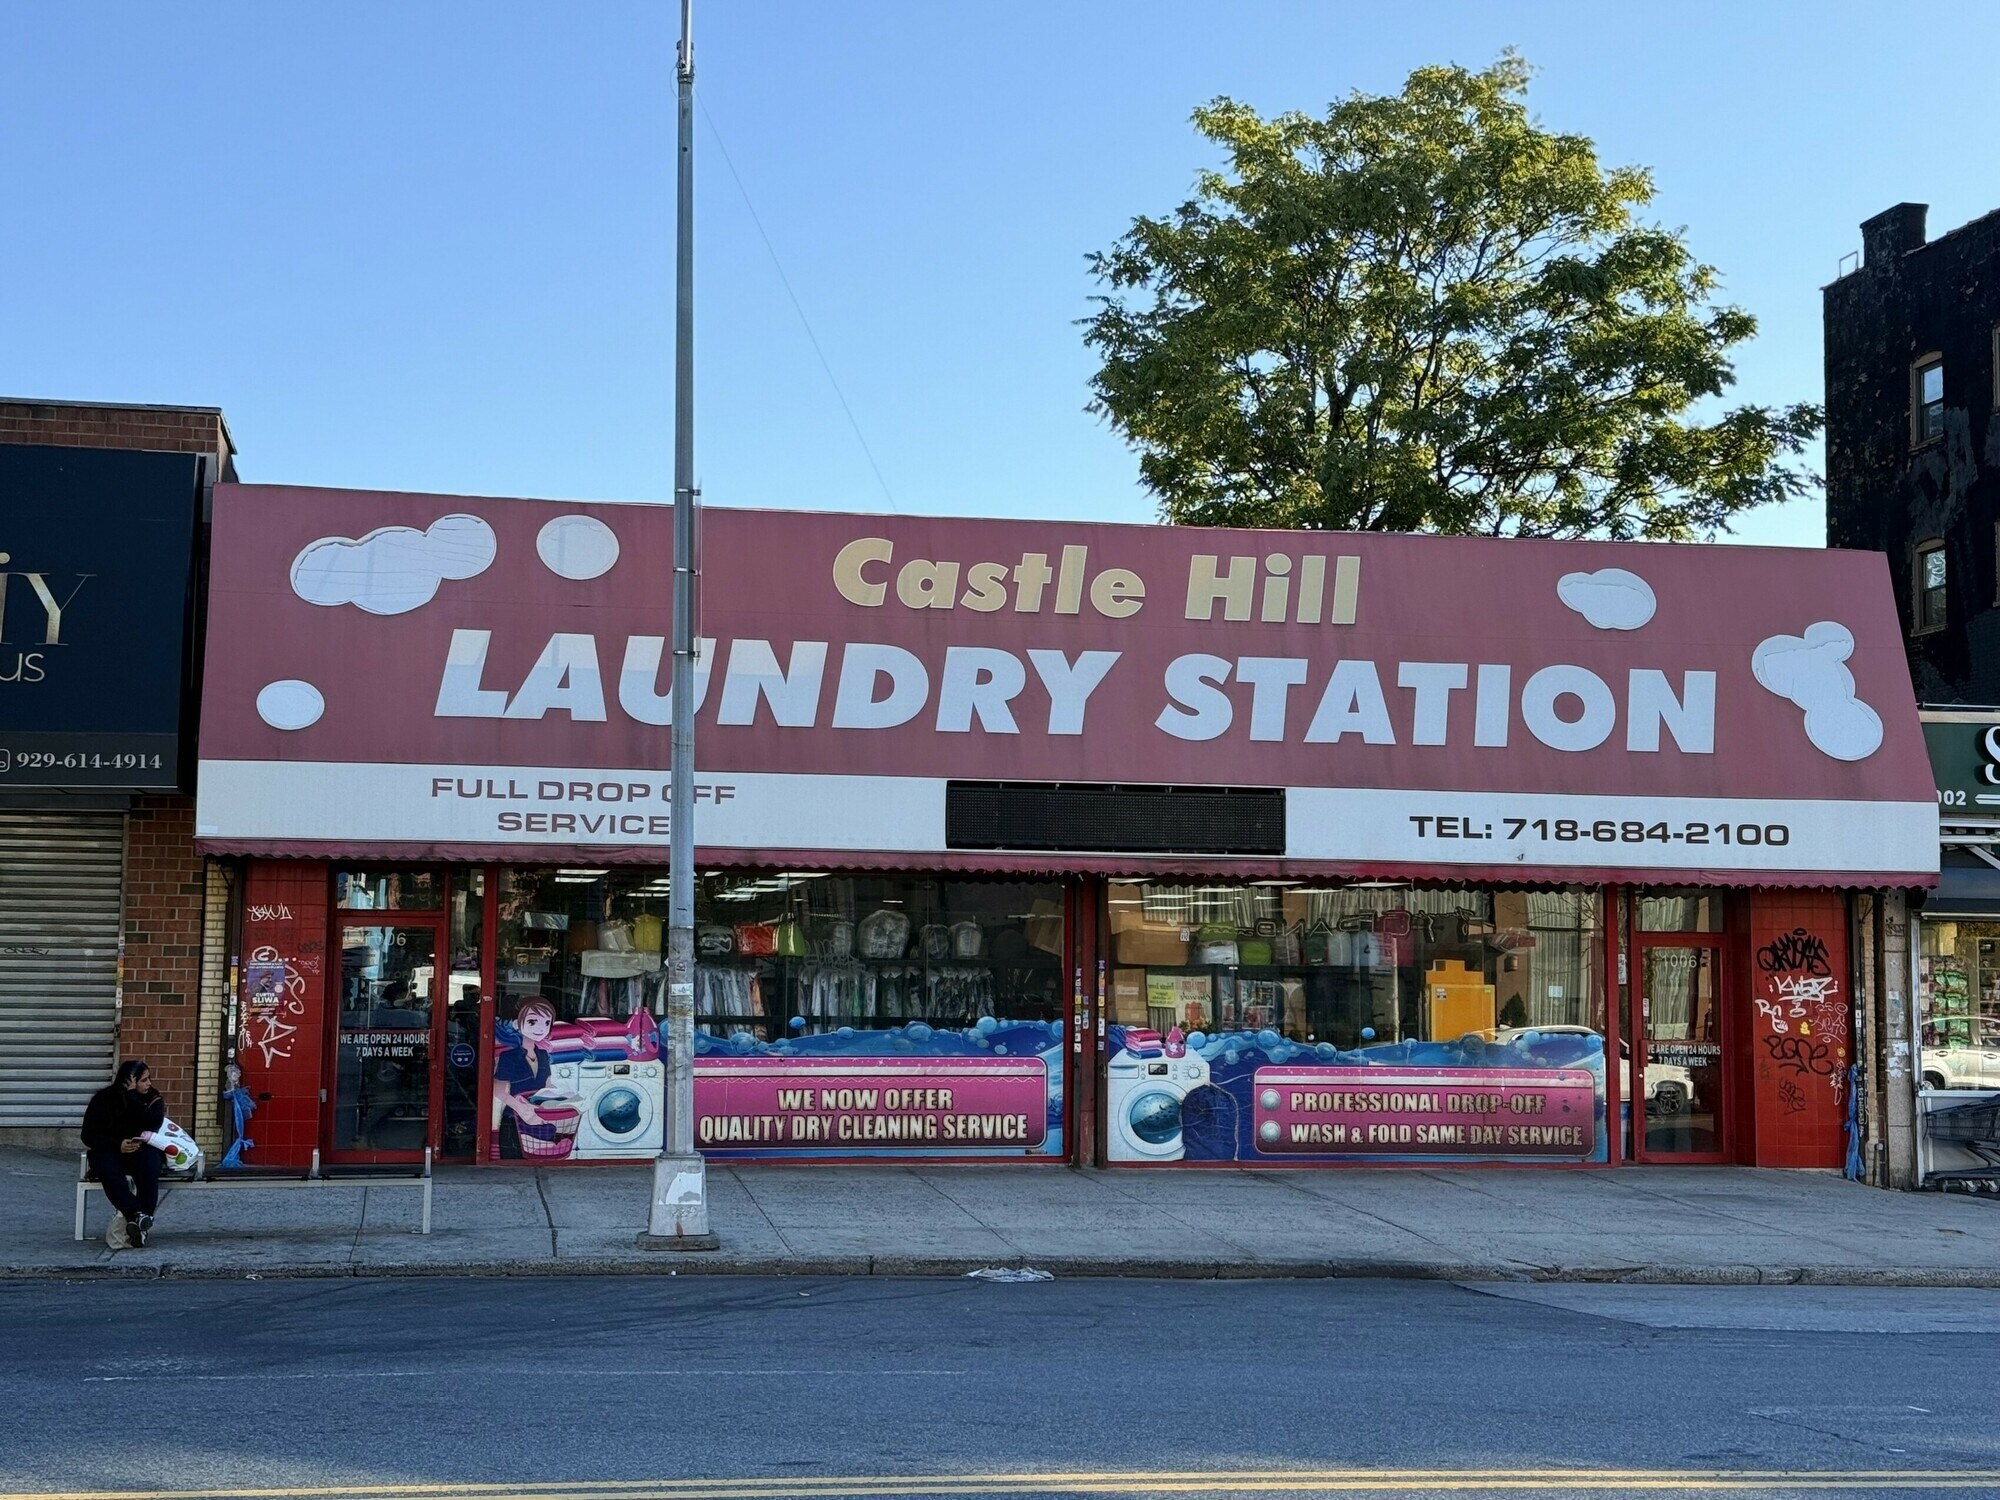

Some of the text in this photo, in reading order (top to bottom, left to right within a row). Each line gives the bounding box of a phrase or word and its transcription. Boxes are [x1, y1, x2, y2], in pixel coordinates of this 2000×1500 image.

[832, 537, 1361, 625] Castle Hill
[434, 628, 1717, 754] LAUNDRY STATION
[16, 751, 162, 770] 929-614-4914
[431, 778, 529, 799] FULL
[538, 781, 651, 802] DROP
[497, 812, 670, 835] SERVICE
[1409, 816, 1790, 846] TEL: 718-684-2100
[1661, 954, 1697, 968] 1006
[340, 1033, 430, 1045] WE ARE OPEN 24 HOURS
[1656, 1044, 1670, 1055] ARE
[1670, 1044, 1688, 1055] OPEN
[1688, 1044, 1698, 1055] 24
[1699, 1045, 1721, 1056] HOURS
[362, 1046, 383, 1057] DAYS
[384, 1046, 390, 1057] A
[391, 1046, 414, 1057] WEEK
[1664, 1055, 1682, 1066] DAYS
[1682, 1056, 1688, 1066] A
[1688, 1056, 1708, 1067] WEEK
[776, 1088, 954, 1111] WE NOW OFFER
[1290, 1093, 1546, 1115] PROFESSIONAL DROP-OFF
[699, 1114, 1029, 1144] QUALITY DRY CLEANING SERVICE
[1290, 1124, 1583, 1147] WASH & FOLD SAME DAY SERVICE
